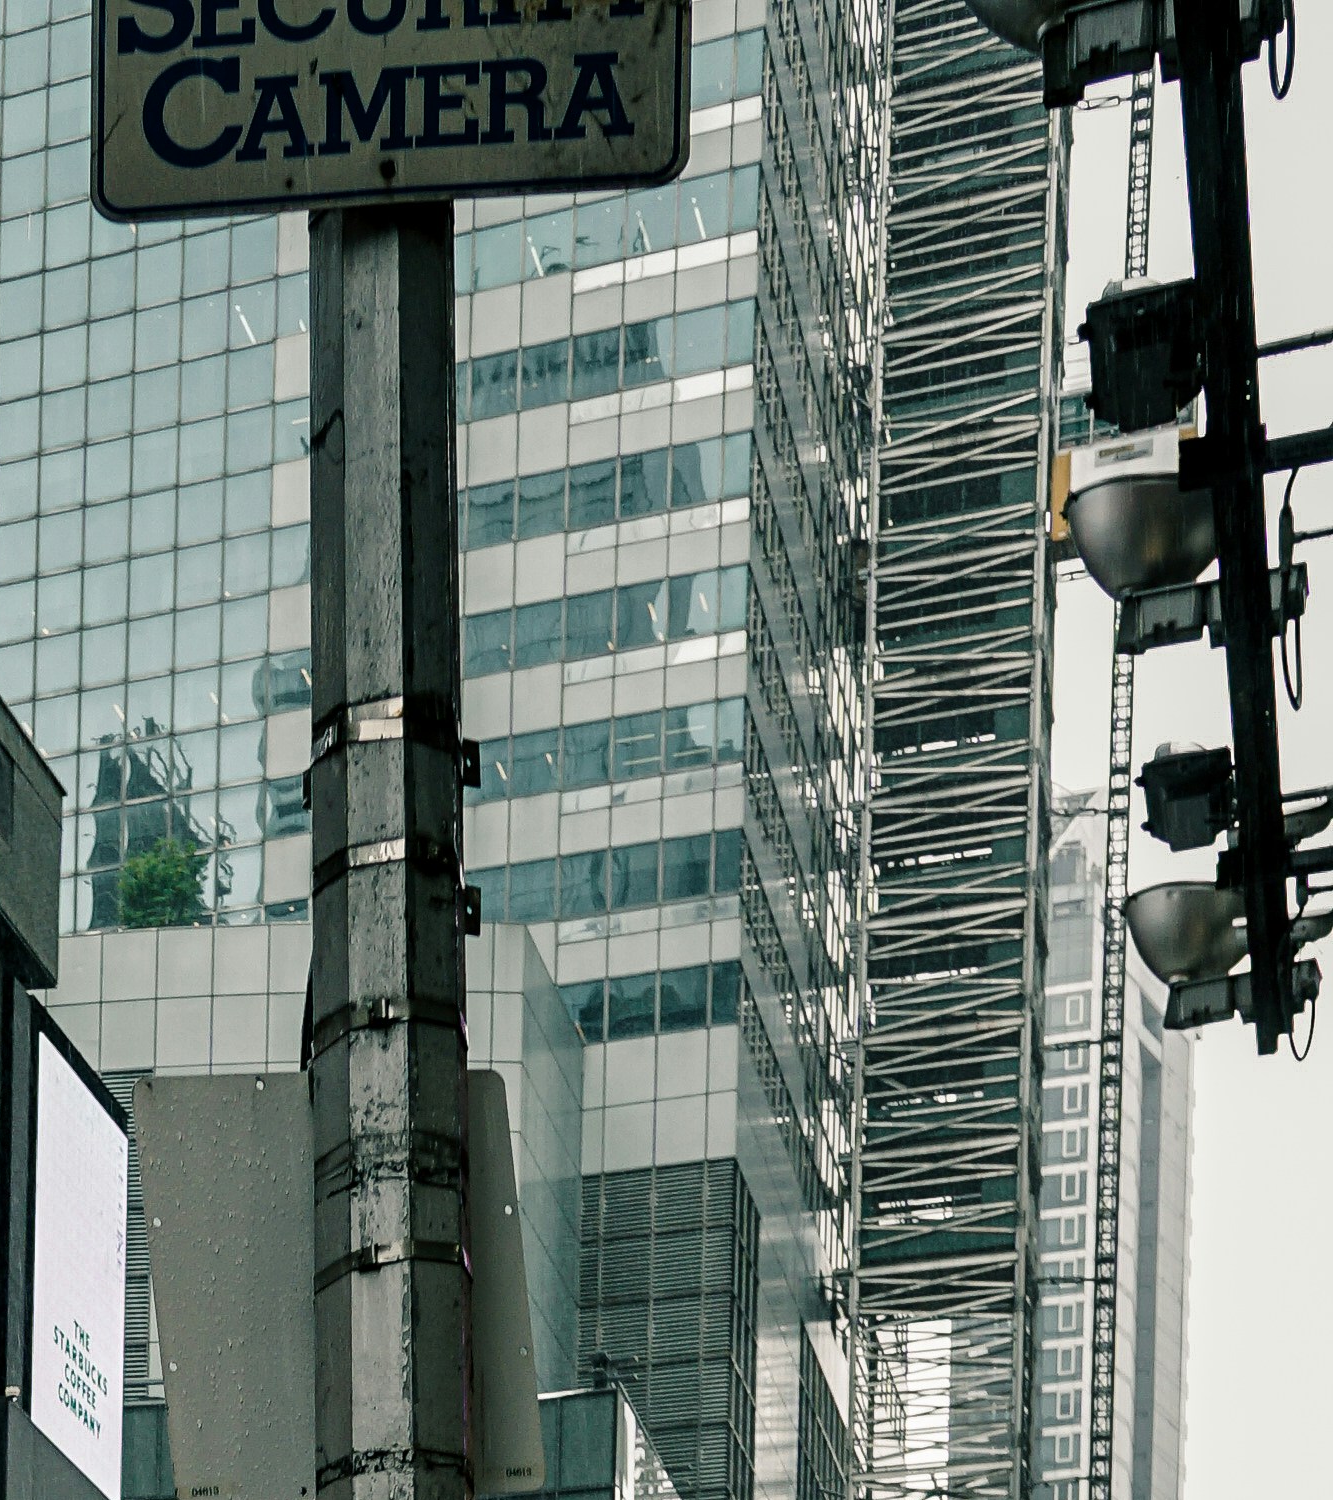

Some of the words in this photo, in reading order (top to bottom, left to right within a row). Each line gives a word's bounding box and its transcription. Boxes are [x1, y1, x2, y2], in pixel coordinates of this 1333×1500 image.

[142, 52, 634, 167] CAMERA
[54, 1325, 107, 1397] STARBUCKS
[73, 1319, 90, 1352] THE
[58, 1382, 101, 1439] COMPANY
[65, 1363, 96, 1410] COFFEE
